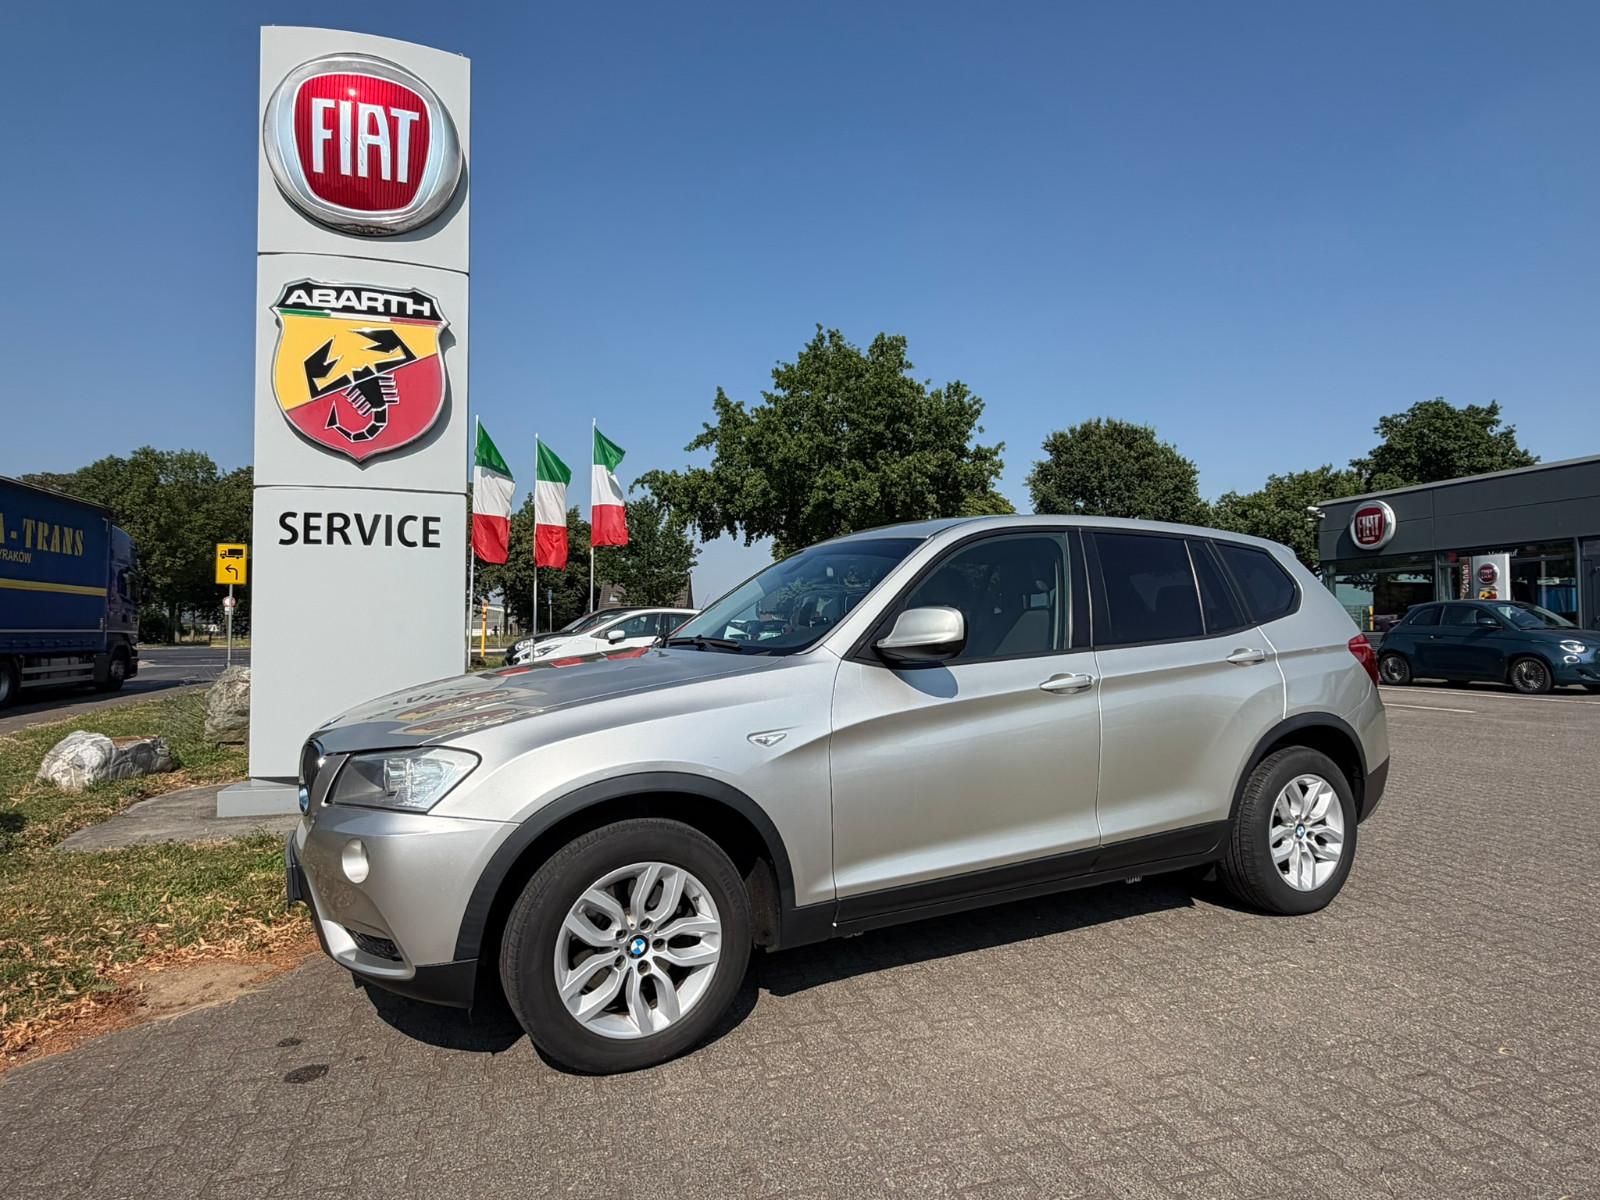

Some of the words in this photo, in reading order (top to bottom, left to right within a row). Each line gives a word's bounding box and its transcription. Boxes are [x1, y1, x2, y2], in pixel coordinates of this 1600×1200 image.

[311, 97, 420, 184] FIAT
[284, 289, 430, 316] ABARTH
[278, 511, 441, 548] SERVICE
[1357, 513, 1382, 538] FIAT
